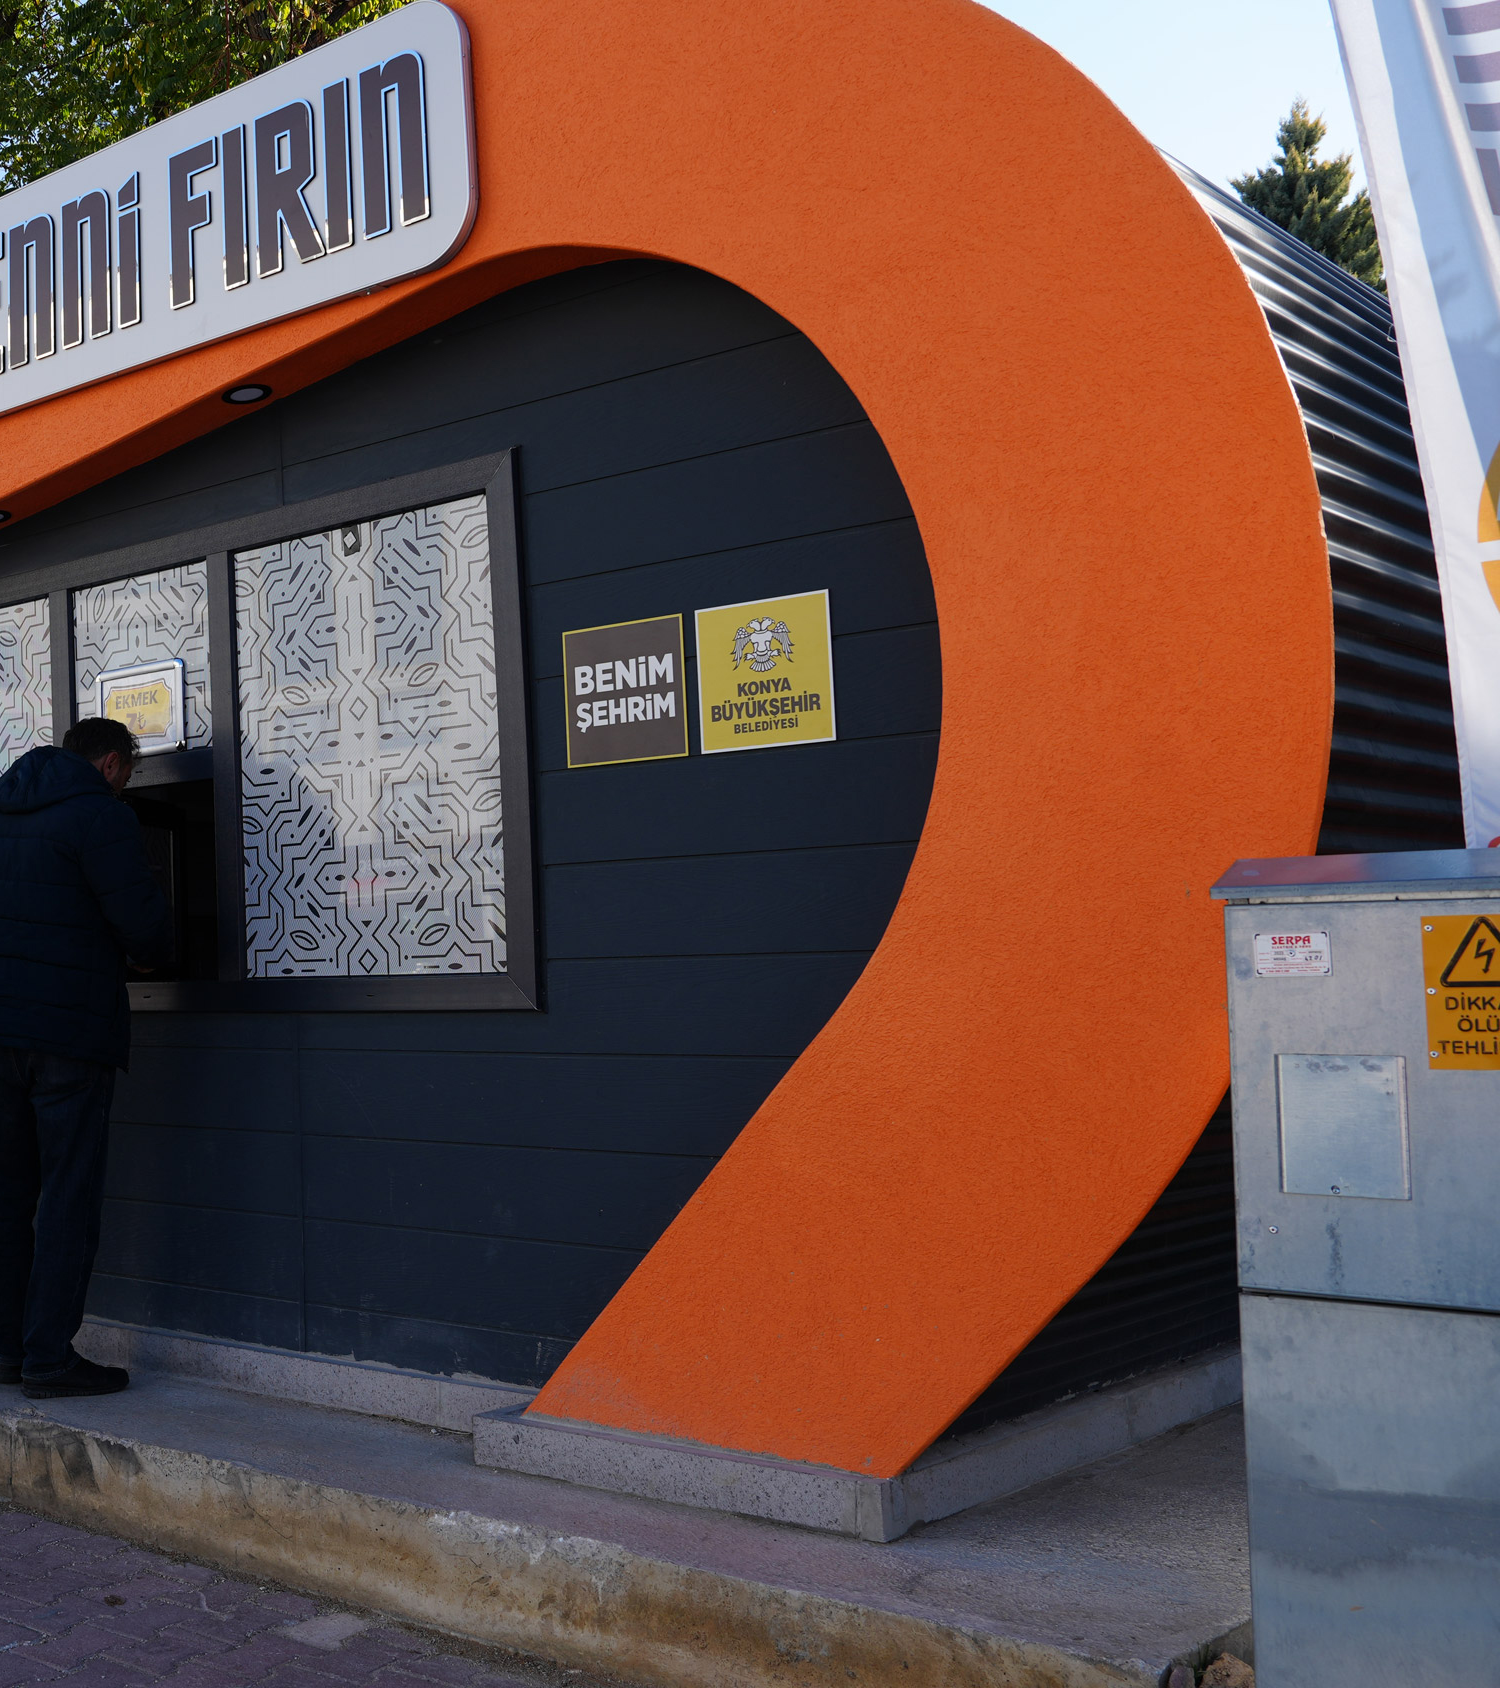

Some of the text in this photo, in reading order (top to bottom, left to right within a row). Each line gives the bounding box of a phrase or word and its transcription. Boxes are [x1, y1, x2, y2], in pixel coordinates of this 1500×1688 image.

[167, 50, 430, 310] FIRIN
[574, 653, 674, 696] BENİM
[737, 677, 792, 698] KONYA
[115, 689, 158, 710] EKMEK
[711, 690, 821, 722] BÜYÜKŞEHİR
[576, 691, 676, 733] ŞEHRİM
[734, 714, 799, 734] BELEDİYESİ
[1271, 935, 1311, 945] SERPA
[1445, 992, 1500, 1010] DİKK
